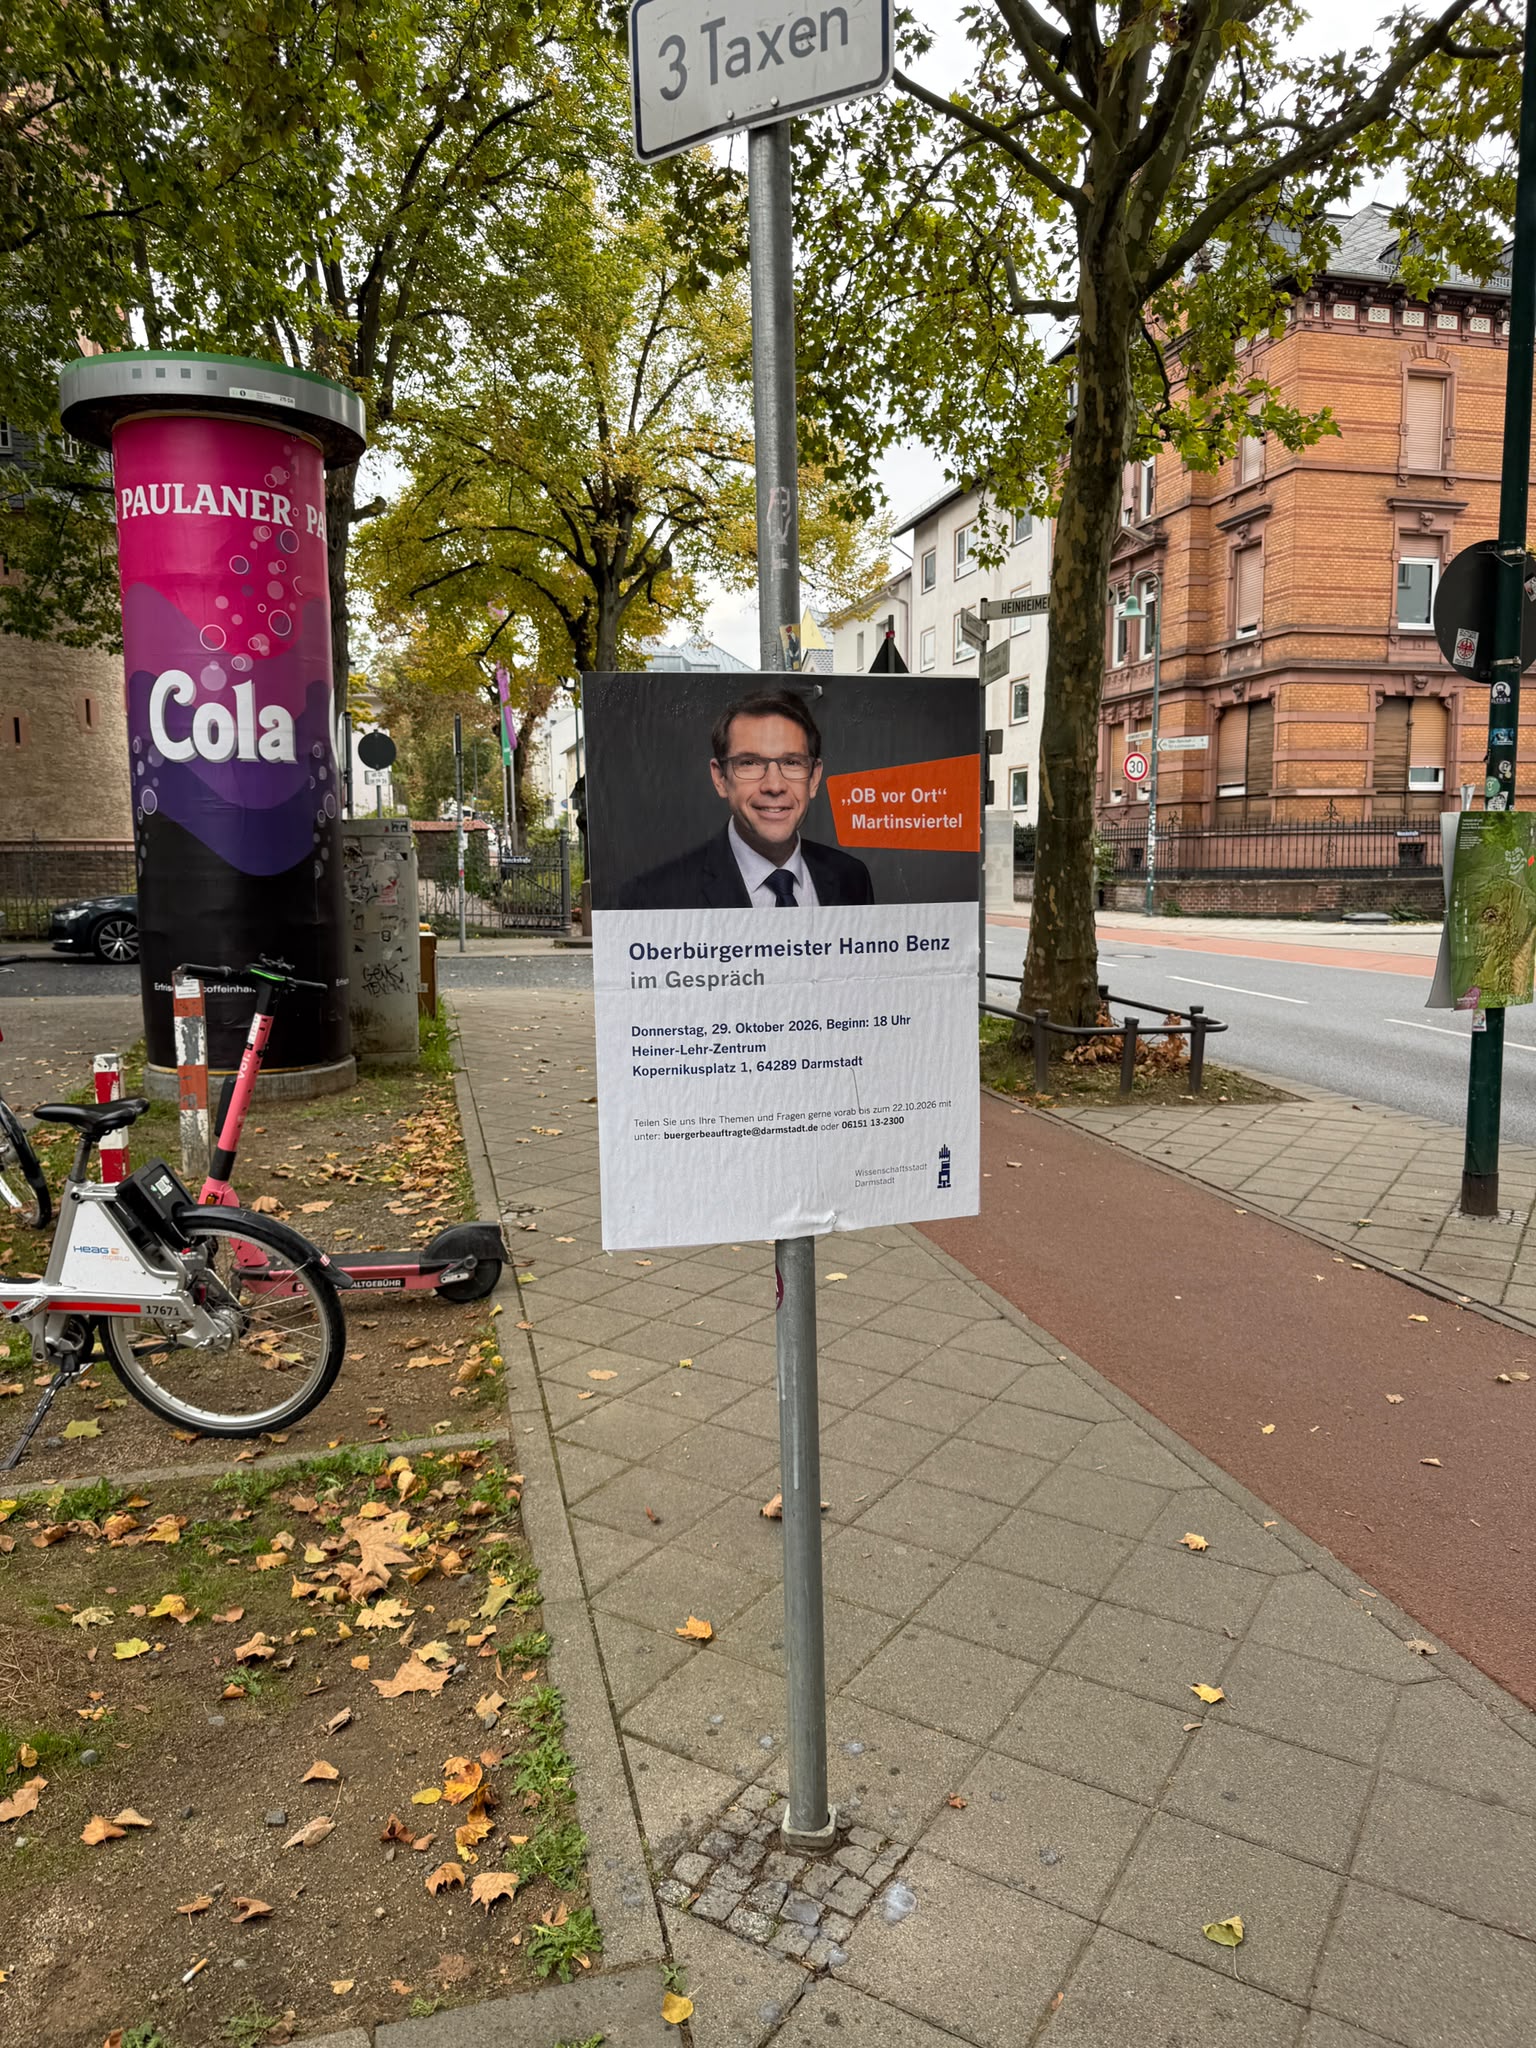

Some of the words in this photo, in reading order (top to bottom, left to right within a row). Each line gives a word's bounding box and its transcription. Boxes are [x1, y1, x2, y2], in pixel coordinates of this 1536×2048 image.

[658, 34, 688, 101] 3
[700, 5, 848, 86] Taxen
[121, 483, 293, 527] PAULANER
[150, 669, 298, 764] Cola
[1129, 760, 1143, 774] 30
[881, 791, 906, 803] vor
[852, 812, 962, 829] Martinsviertel
[629, 939, 832, 963] Oberbürgermeister
[839, 937, 899, 955] Hanno
[906, 935, 950, 952] Benz
[631, 971, 657, 989] im
[665, 968, 765, 991] Gespräch
[631, 1025, 707, 1038] Donnerstag,
[711, 1023, 731, 1035] 29.
[735, 1021, 784, 1034] Oktober
[788, 1019, 822, 1032] 2026,
[826, 1017, 869, 1031] Beginn:
[873, 1015, 888, 1027] 18
[891, 1014, 911, 1026] Uhr
[632, 1042, 767, 1057] Heiner-Lehr-Zentrum
[632, 1062, 736, 1078] Kopernikusplatz
[740, 1061, 752, 1074] 1,
[756, 1059, 797, 1072] 64289
[801, 1055, 863, 1070] Darmstadt
[634, 1118, 660, 1127] Teilen
[663, 1117, 677, 1126] Sie
[680, 1118, 696, 1126] uns
[698, 1116, 716, 1125] Ihre
[719, 1115, 755, 1124] Themen
[757, 1113, 774, 1122] und
[776, 1112, 806, 1121] Fragen
[808, 1110, 832, 1120] gerne
[834, 1108, 856, 1117] vorab
[858, 1107, 870, 1115] bis
[873, 1105, 890, 1114] zum
[892, 1100, 937, 1112] 22.10.2026
[939, 1100, 952, 1108] mit
[634, 1132, 661, 1141] unter:
[663, 1123, 818, 1140] buergerbeauftragte@darmstadt.de
[820, 1122, 839, 1131] oder
[841, 1119, 868, 1129] 06151
[870, 1115, 905, 1127] 13-2300
[855, 1163, 928, 1177] Wissenschaftsstadt
[855, 1177, 895, 1188] Darmstadt
[146, 1305, 180, 1316] 17671
